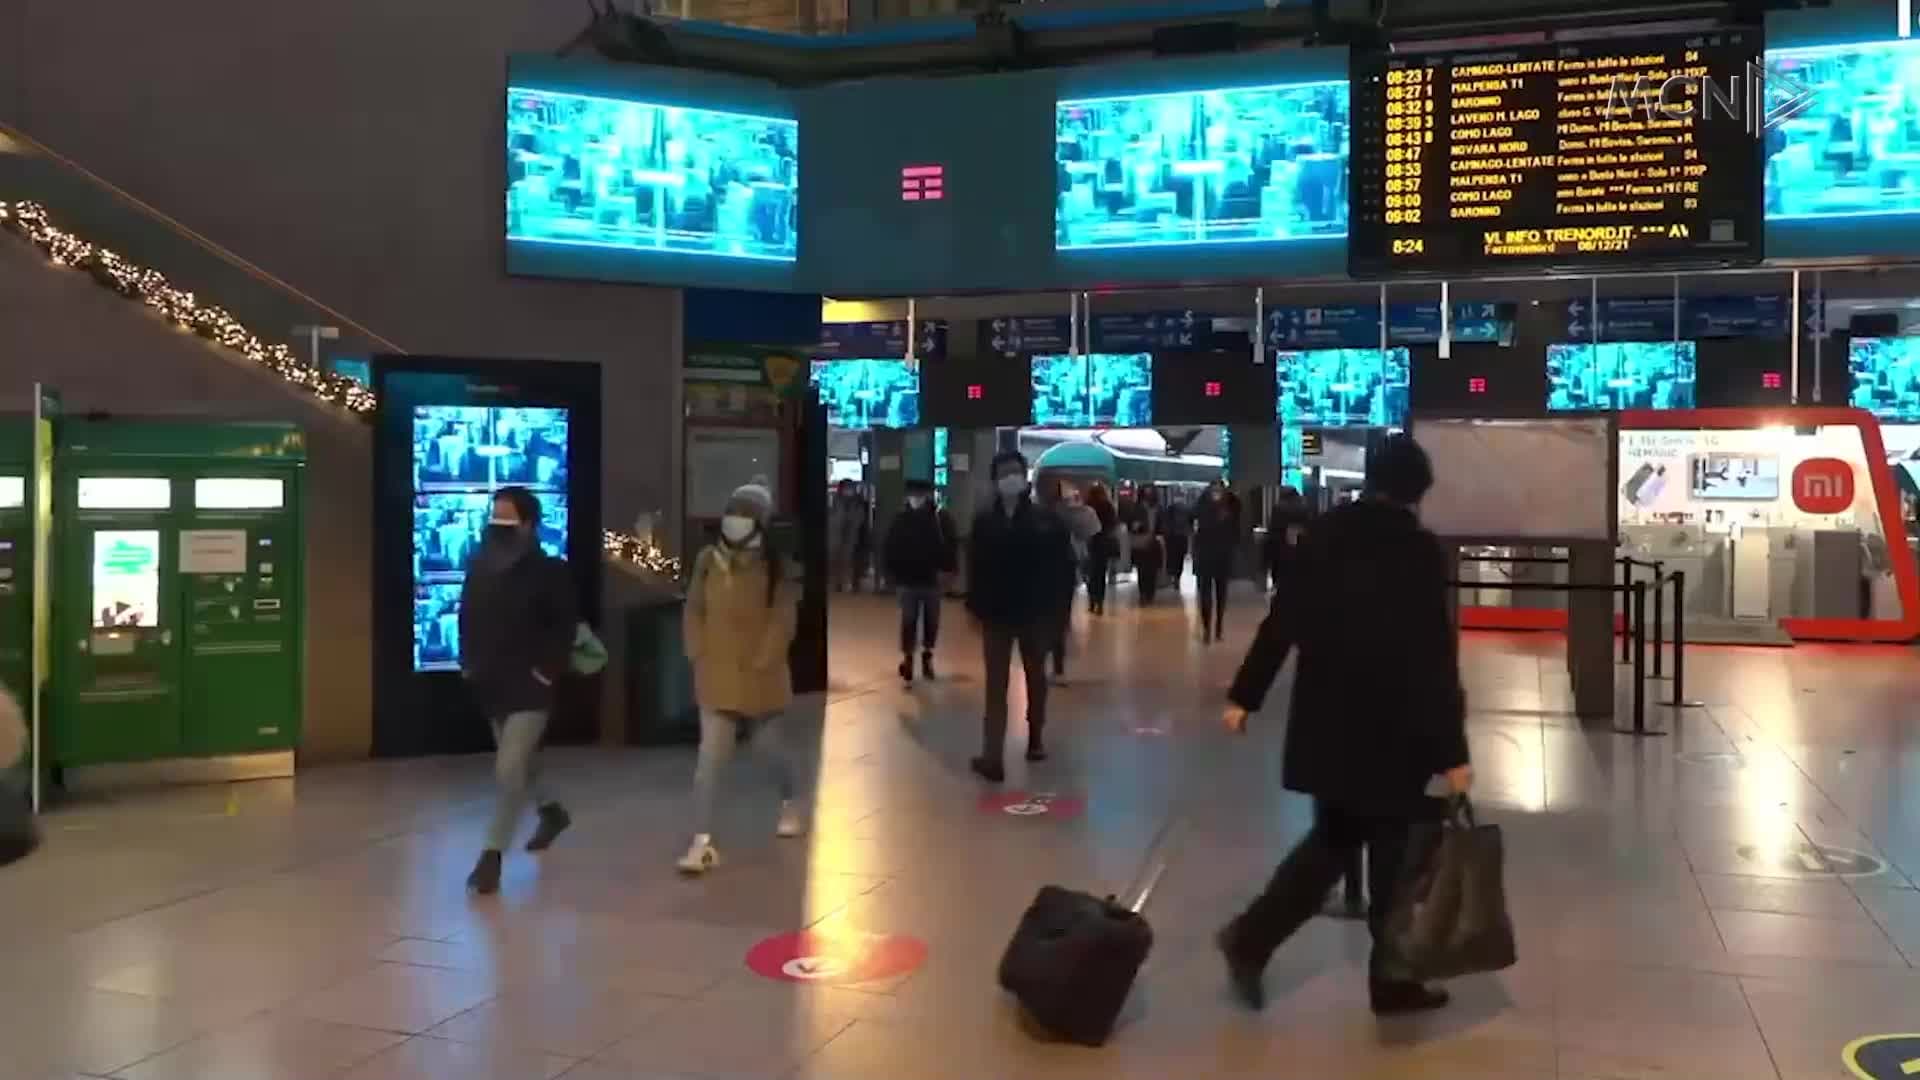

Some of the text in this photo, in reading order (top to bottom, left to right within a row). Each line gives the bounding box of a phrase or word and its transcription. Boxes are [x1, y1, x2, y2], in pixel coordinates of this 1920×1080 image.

[1386, 70, 1422, 84] 08:23
[1426, 68, 1434, 82] 7
[1386, 85, 1422, 100] 08:27
[1426, 84, 1433, 96] 1
[1451, 81, 1508, 94] MALPENSA
[1511, 78, 1524, 89] T1
[1386, 100, 1422, 116] 08:32
[1451, 96, 1502, 108] SARONNO
[1386, 116, 1422, 130] 08:39
[1425, 115, 1434, 128] 3
[1451, 112, 1494, 124] LAVENO
[1510, 109, 1540, 121] LAGO
[1386, 131, 1422, 146] 08:43
[1451, 128, 1481, 140] COMO
[1483, 126, 1513, 138] LAGO
[1386, 146, 1421, 162] 08:47
[1451, 143, 1496, 156] NOVARA
[1498, 141, 1528, 152] NORD
[1386, 162, 1421, 178] 08:53
[1386, 178, 1421, 192] 08:57
[1450, 174, 1507, 186] MALPENSA
[1510, 173, 1522, 184] T1
[1386, 194, 1421, 208] 09:00
[1450, 191, 1480, 202] COMO
[1483, 189, 1512, 200] LAGO
[1386, 209, 1421, 224] 09:02
[1450, 206, 1500, 218] SARONNO
[1506, 230, 1540, 243] INFO
[1393, 239, 1424, 254] 8:24
